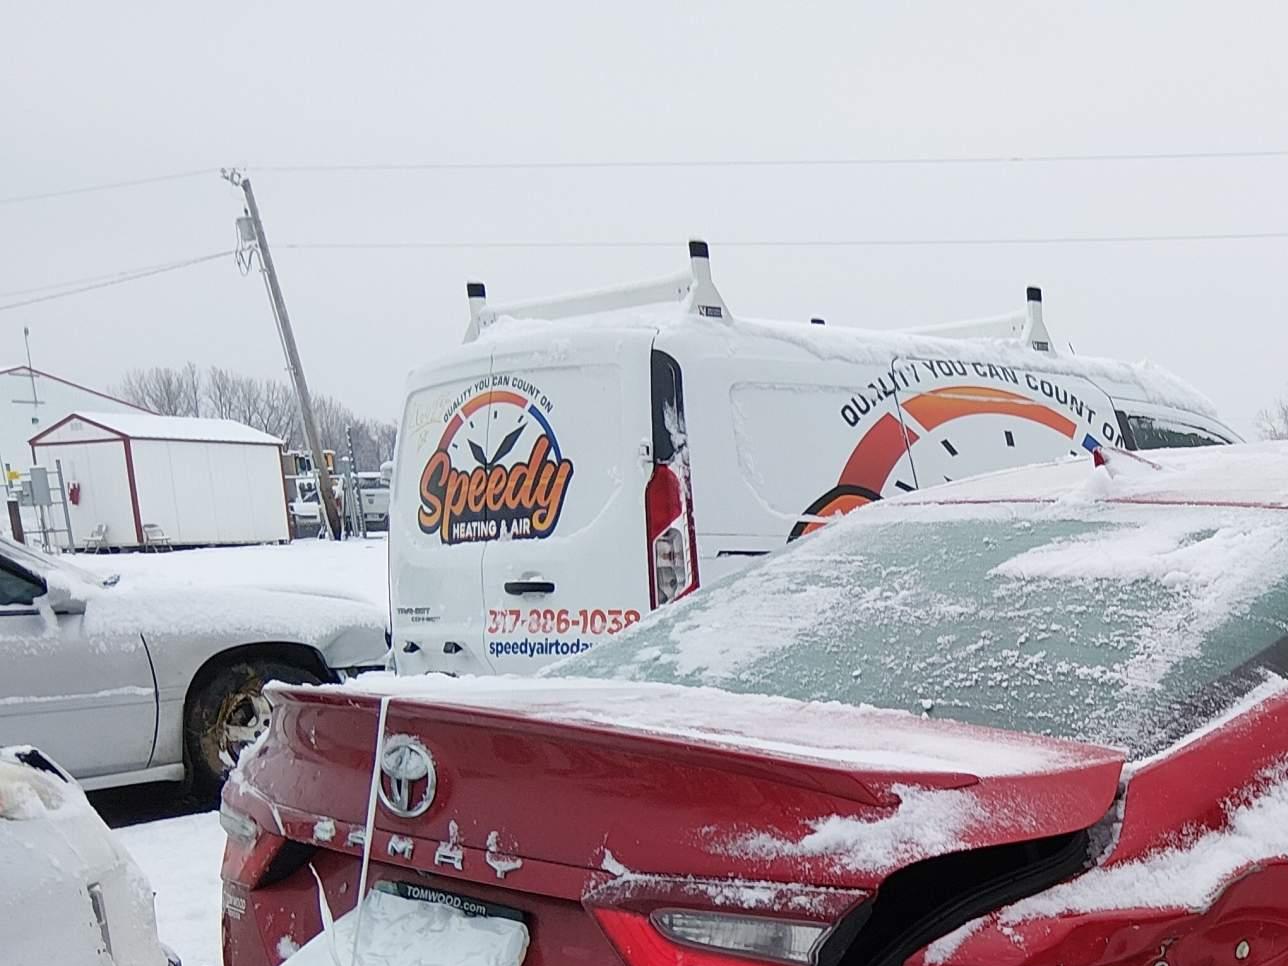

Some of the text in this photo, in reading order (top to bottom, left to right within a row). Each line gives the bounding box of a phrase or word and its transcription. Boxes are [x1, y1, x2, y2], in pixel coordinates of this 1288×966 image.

[443, 375, 554, 423] QUALITY YOU CAN COUNT ON
[922, 359, 968, 379] YOU
[972, 362, 1019, 385] CAN
[1025, 373, 1096, 425] COUNT
[418, 434, 573, 545] Speedy
[452, 519, 497, 540] HEATING
[511, 518, 531, 535] AIR
[489, 637, 593, 658] speedyairtoda
[407, 884, 487, 915] TOMWOOD.com
